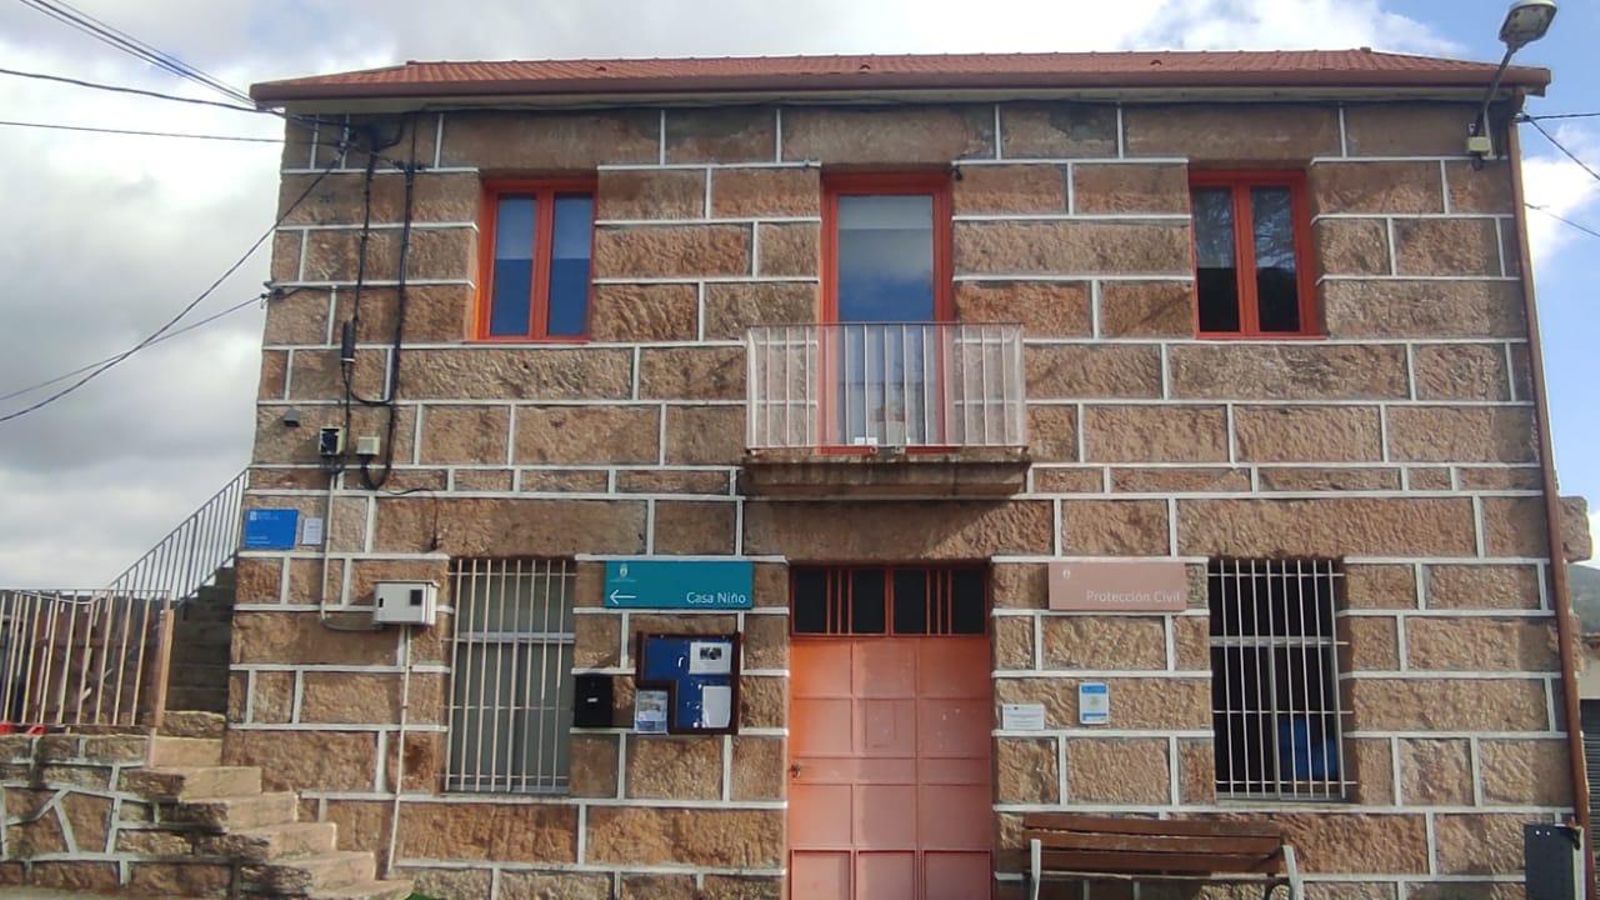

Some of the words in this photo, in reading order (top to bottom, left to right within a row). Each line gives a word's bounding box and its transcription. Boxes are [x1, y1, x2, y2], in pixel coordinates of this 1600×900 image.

[686, 591, 714, 604] Casa
[717, 591, 746, 604] Niño
[1154, 590, 1180, 602] Civil
